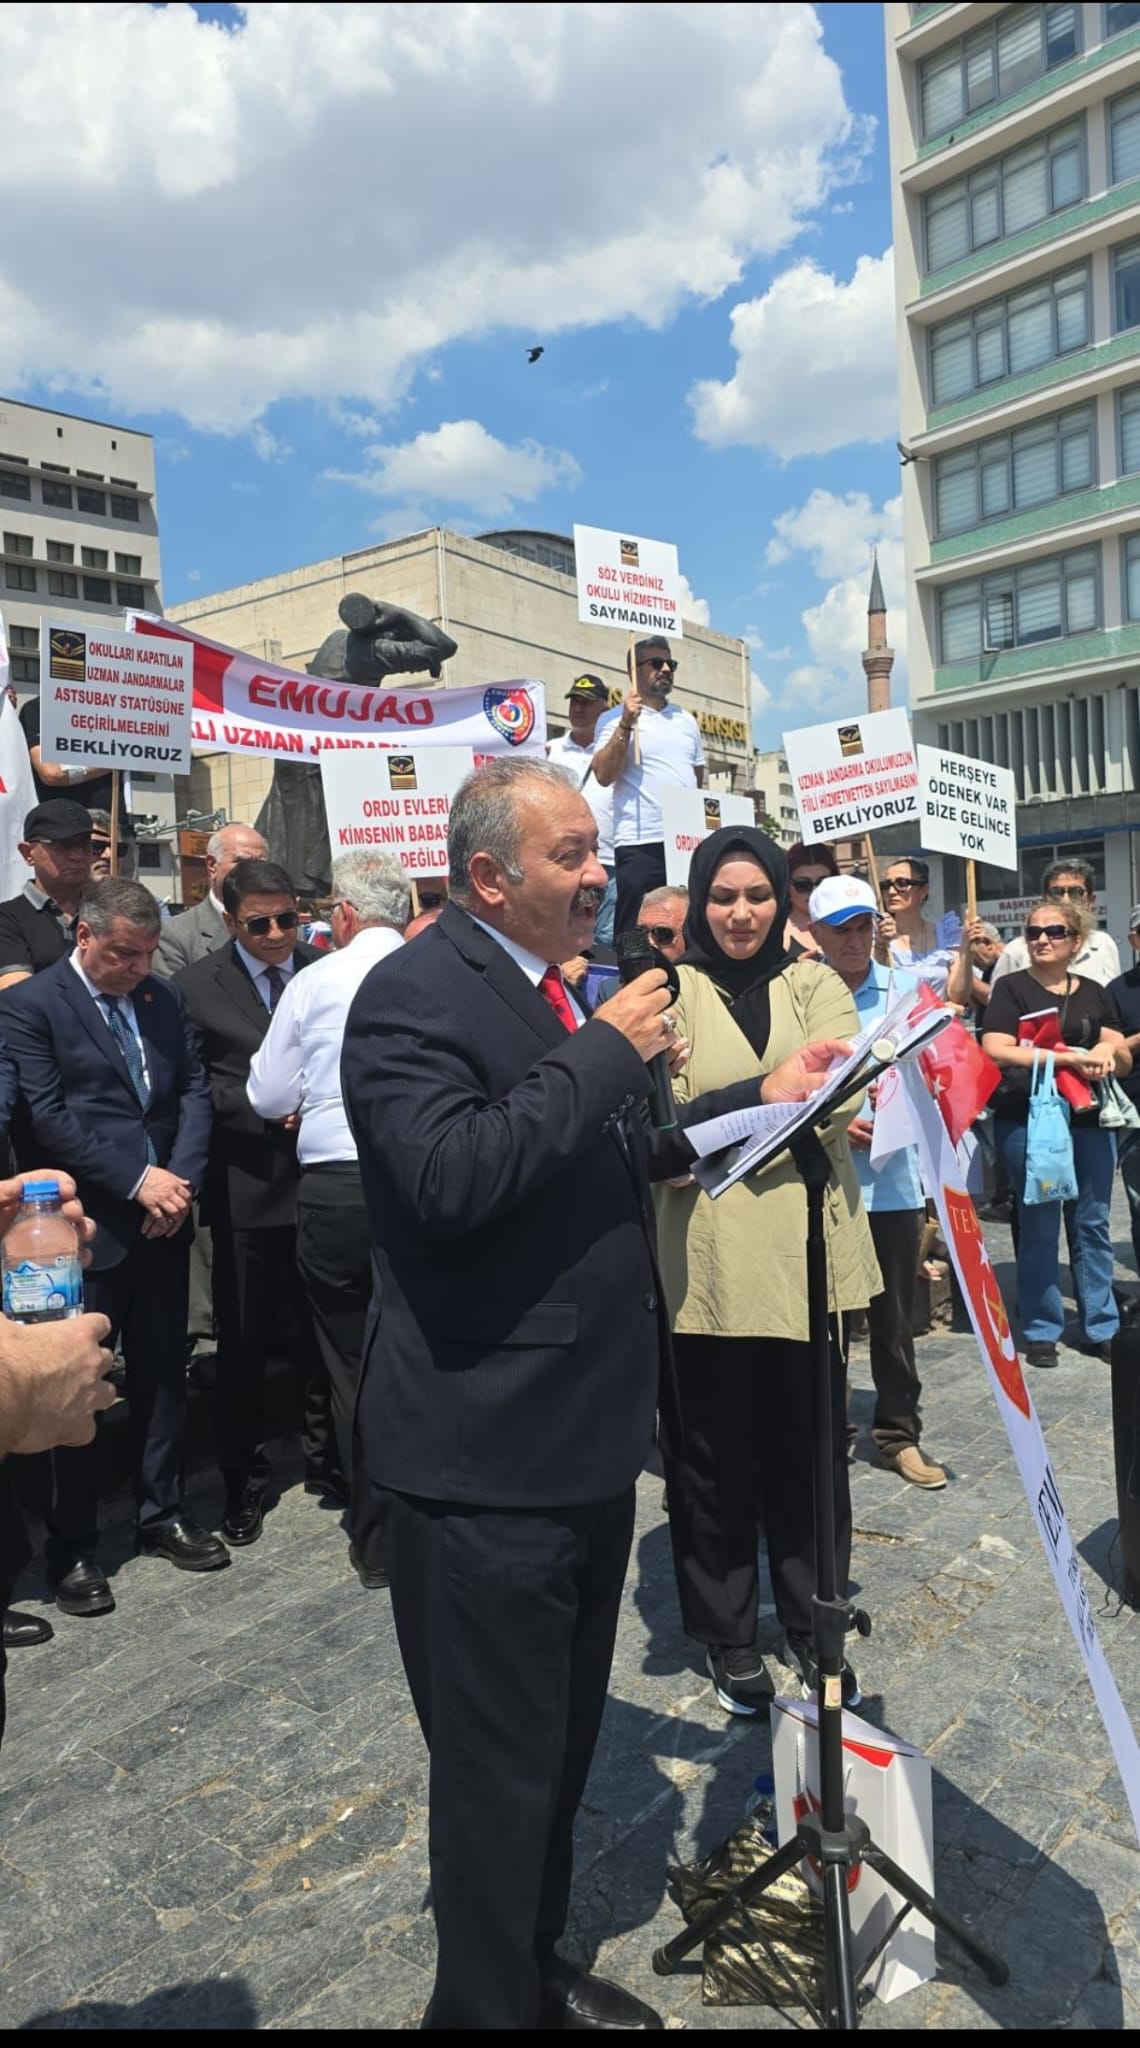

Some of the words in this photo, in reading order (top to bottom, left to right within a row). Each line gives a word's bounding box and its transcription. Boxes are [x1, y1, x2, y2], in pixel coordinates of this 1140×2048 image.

[598, 565, 617, 582] SÖZ
[620, 571, 664, 591] VERDİNİZ
[586, 584, 620, 601] OKULU
[623, 589, 676, 612] HİZMETTEN
[589, 603, 676, 631] SAYMADINIZ
[88, 641, 134, 662] OKULLARI
[136, 650, 183, 669] KAPATILAN
[87, 666, 119, 684] UZMAN
[122, 672, 184, 692] JANDARMALAR
[54, 687, 117, 707] ASTSUBAY
[120, 695, 184, 716] STATÜSÜNE
[71, 714, 170, 737] GEÇİRİLMELERİNİ
[223, 725, 304, 754] UZMAN
[55, 737, 182, 762] BEKLİYORUZ
[798, 769, 825, 791] UZMAN
[826, 762, 864, 785] JANDARMA
[865, 751, 914, 775] OKULUMUZUN
[940, 758, 997, 788] HERŞEYE
[363, 799, 400, 817] ORDU
[403, 793, 449, 816] EVLERİ
[929, 776, 982, 805] ÖDENEK
[985, 794, 1008, 813] VAR
[813, 795, 917, 834] BEKLİYORUZ
[927, 800, 957, 821] BİZE
[961, 810, 1011, 837] GELİNCE
[339, 822, 405, 845] KİMSENİN
[408, 824, 450, 843] BABAS
[959, 832, 985, 852] YOK
[400, 846, 448, 868] DEĞİLD
